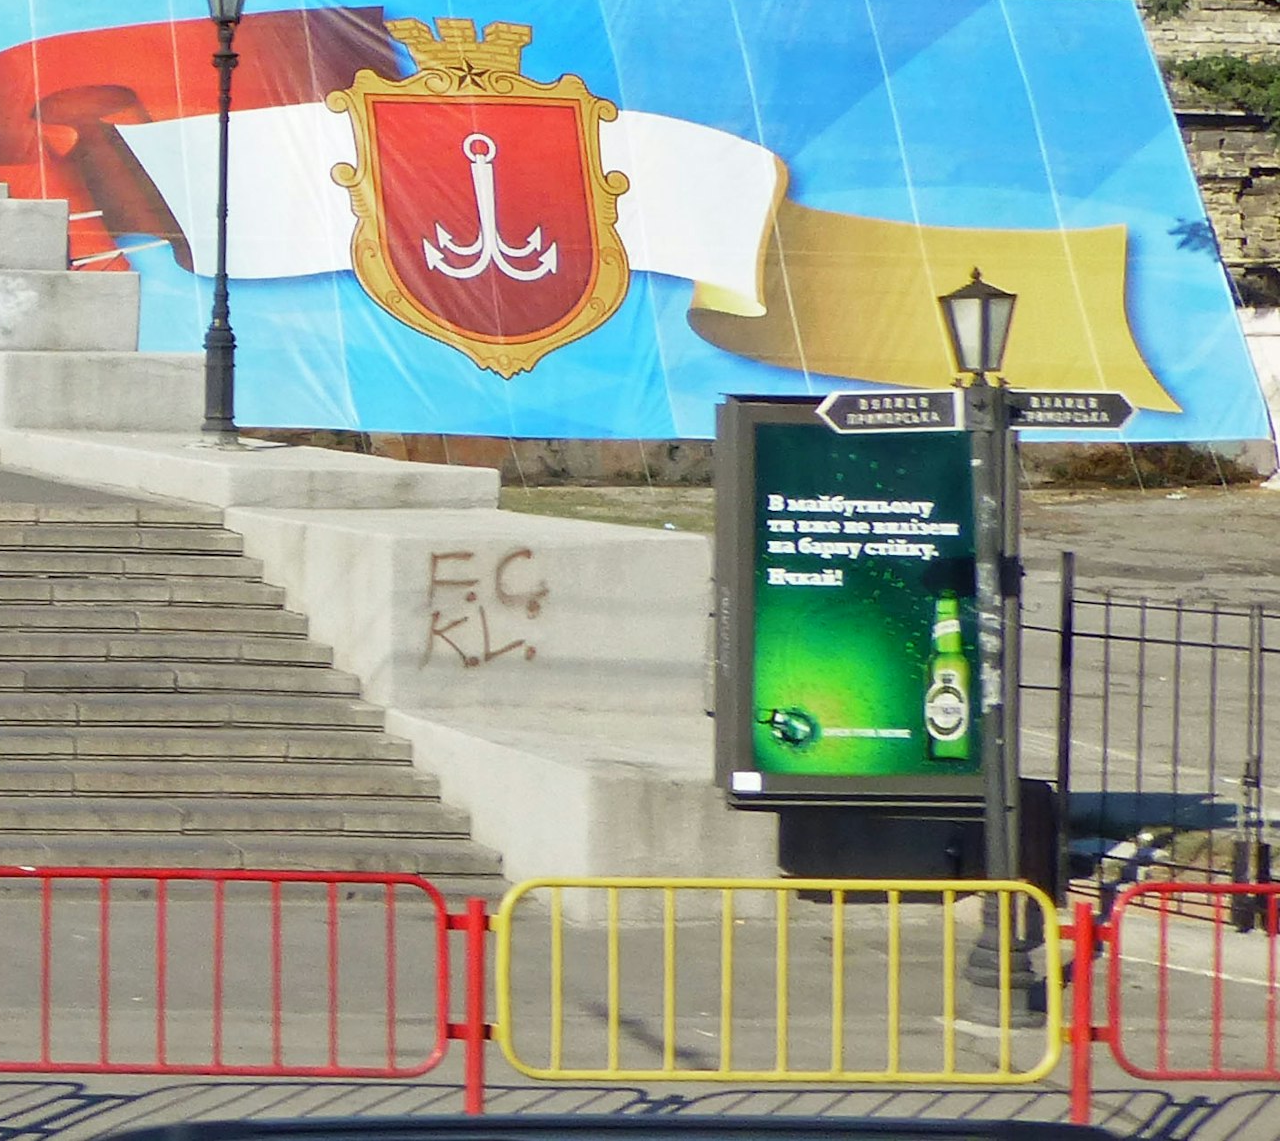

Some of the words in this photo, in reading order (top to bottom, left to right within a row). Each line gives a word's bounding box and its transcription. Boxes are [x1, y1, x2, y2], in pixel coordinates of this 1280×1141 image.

[767, 494, 785, 511] В
[786, 494, 934, 518] майбутньому
[797, 520, 841, 533] вже
[843, 521, 871, 534] не
[767, 540, 796, 554] на
[798, 537, 862, 559] барну
[864, 539, 939, 560] стійку.
